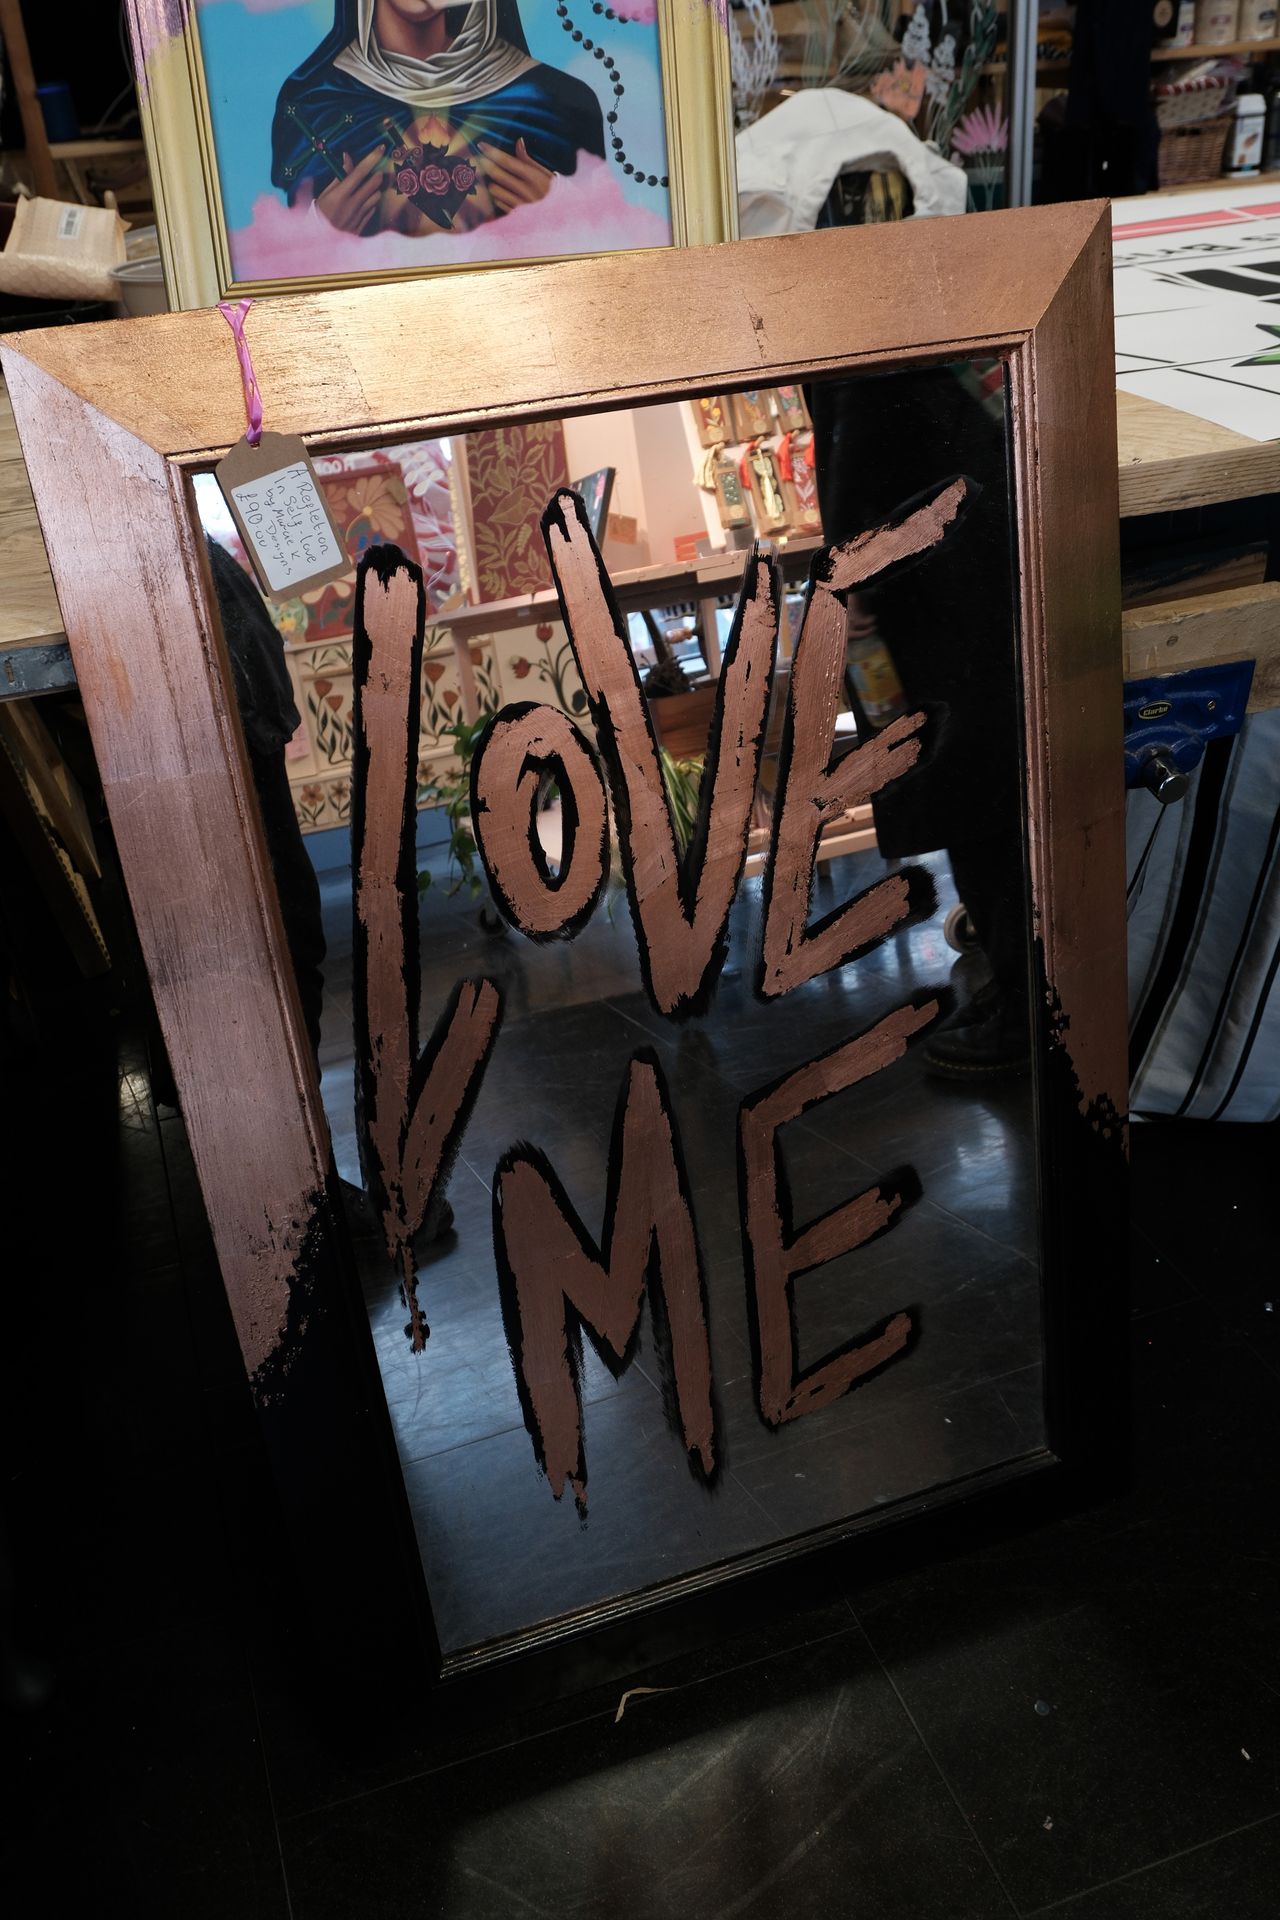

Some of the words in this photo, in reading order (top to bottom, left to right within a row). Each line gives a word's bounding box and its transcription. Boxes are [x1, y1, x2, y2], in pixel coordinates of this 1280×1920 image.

[288, 469, 309, 480] A
[274, 476, 286, 495] In
[264, 488, 276, 507] by
[351, 477, 976, 1354] LOVE
[493, 986, 957, 1526] ME
